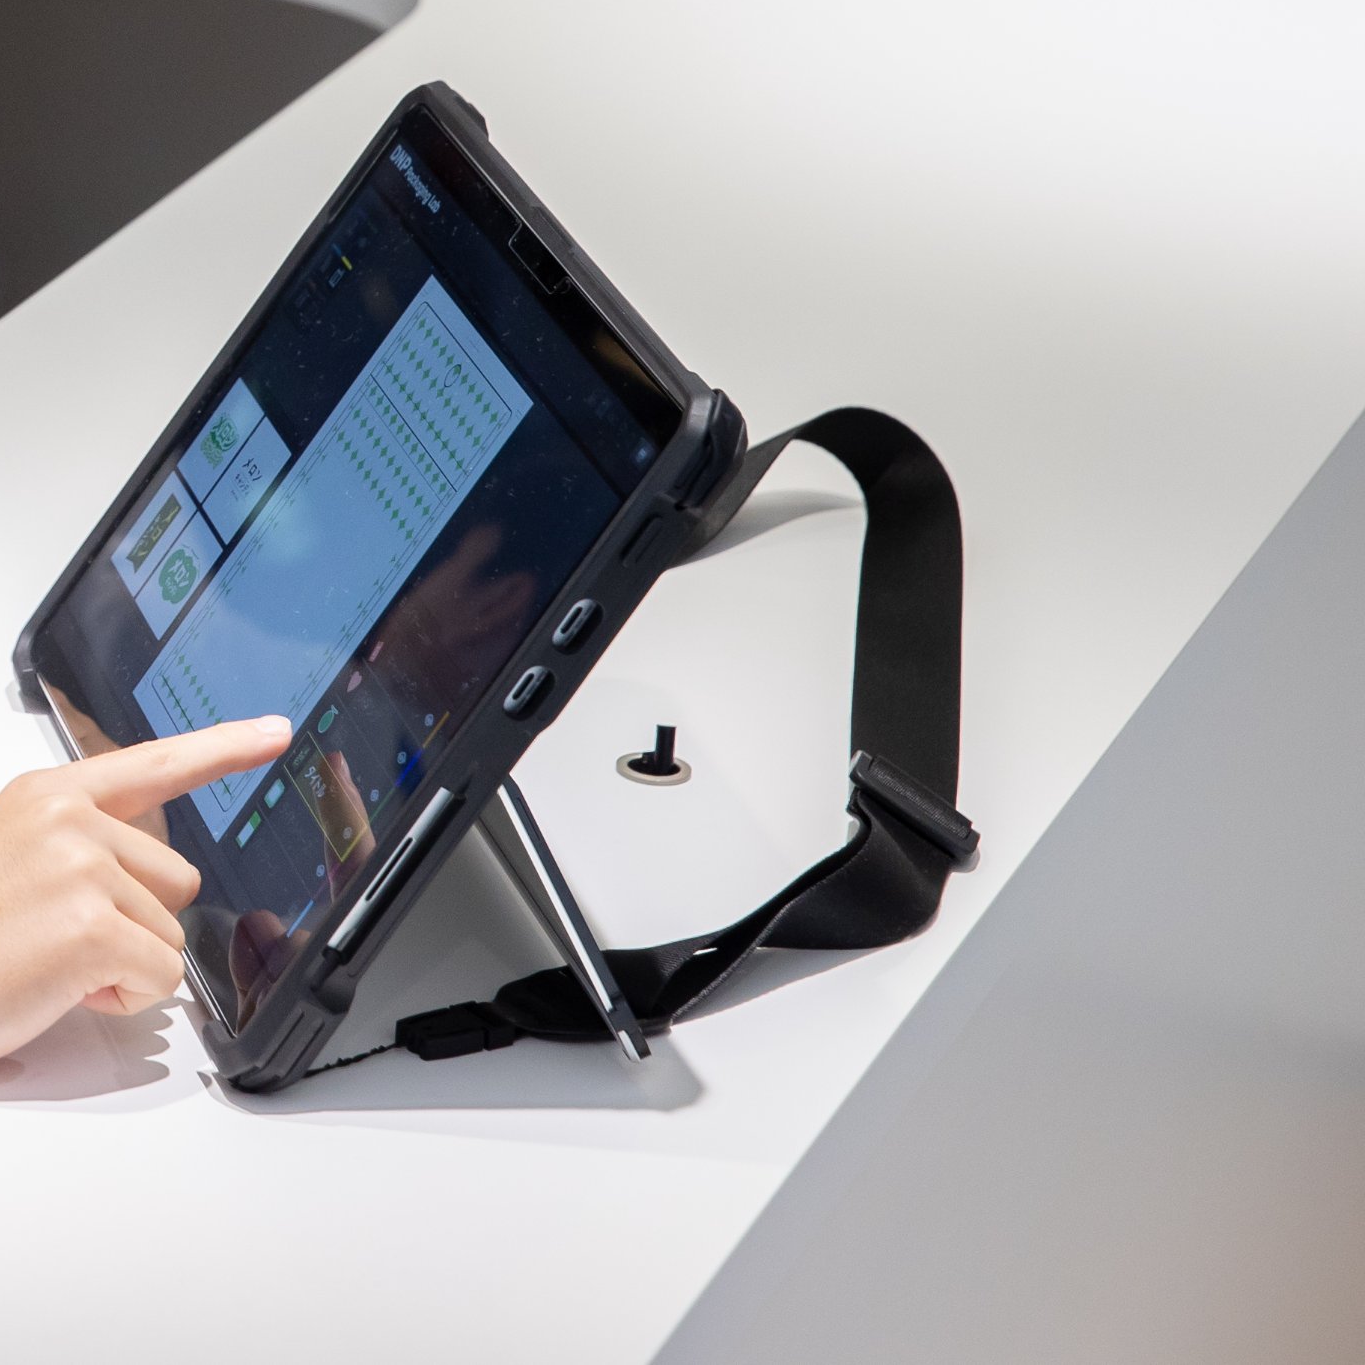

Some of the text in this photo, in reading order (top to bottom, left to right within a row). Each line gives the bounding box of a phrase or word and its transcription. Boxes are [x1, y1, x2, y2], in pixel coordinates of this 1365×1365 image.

[390, 144, 412, 171] DNP
[428, 194, 441, 214] Lab
[242, 457, 263, 482] メロン
[168, 558, 190, 588] メロン
